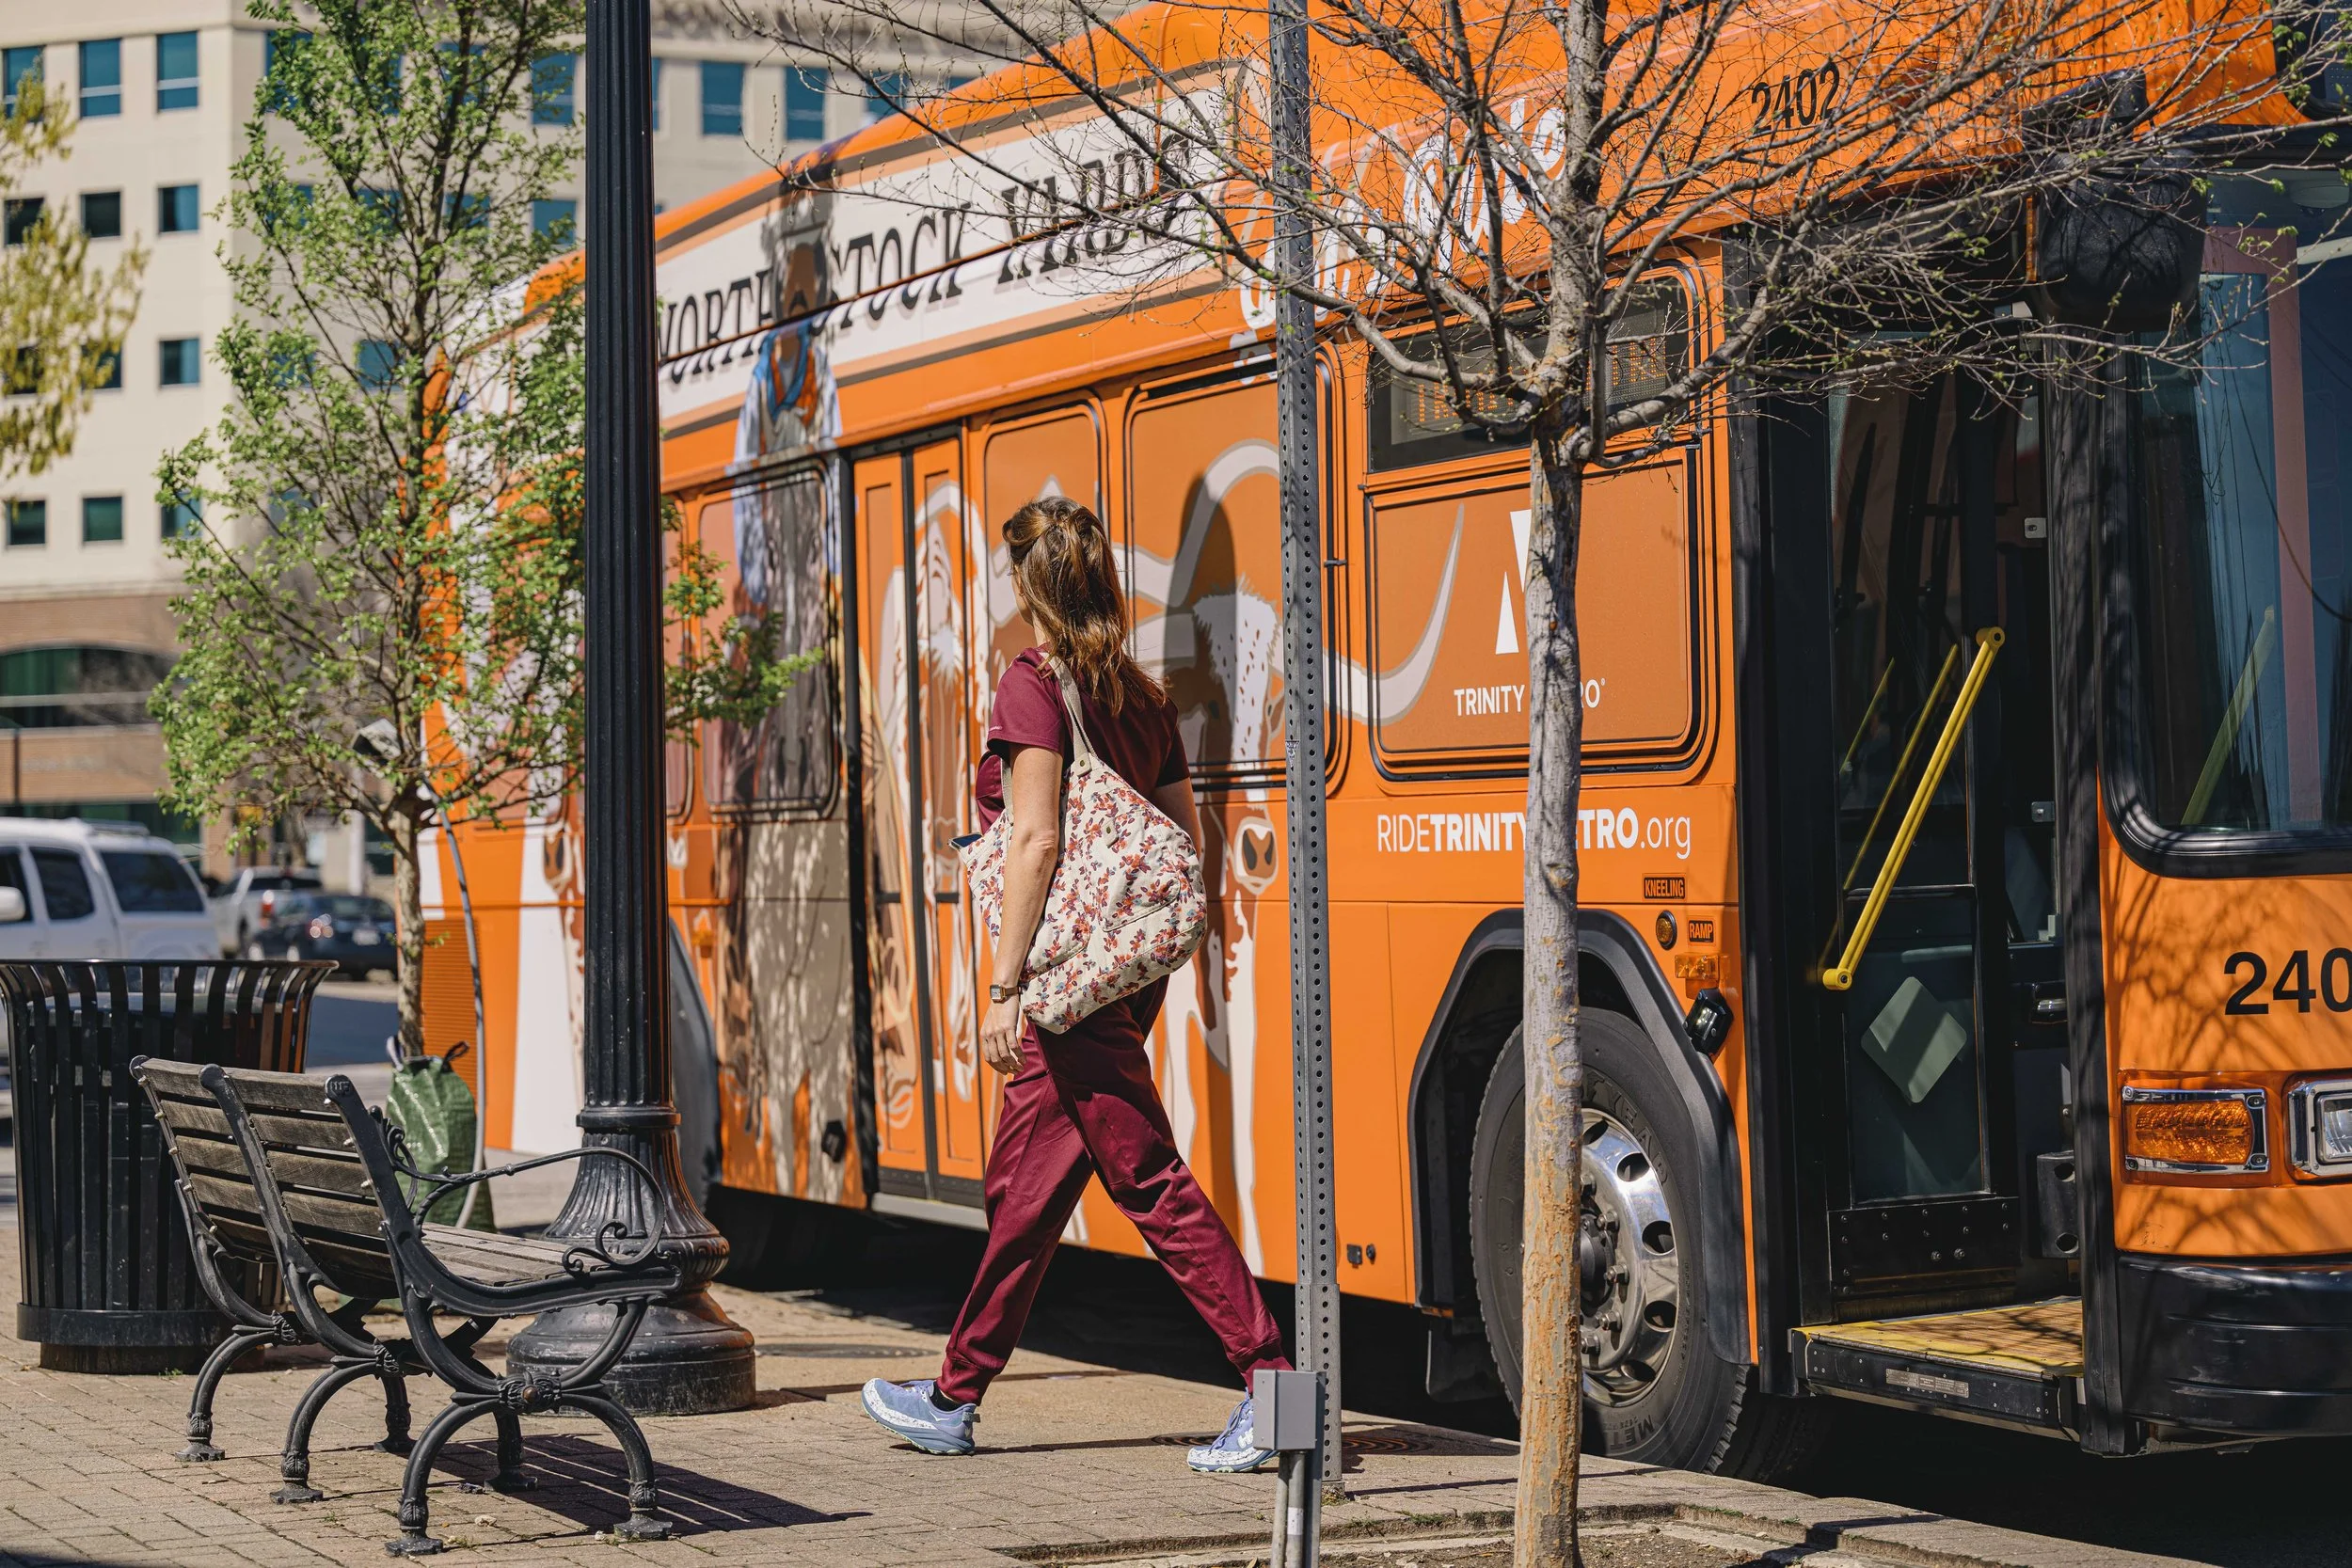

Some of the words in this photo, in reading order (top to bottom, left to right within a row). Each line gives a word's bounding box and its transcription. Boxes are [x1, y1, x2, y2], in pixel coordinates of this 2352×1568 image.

[1751, 62, 1839, 135] 2402
[1454, 684, 1525, 716] TRINITY
[1376, 807, 1692, 860] RIDETRINITTRO.org
[1645, 879, 1685, 897] KNEELING
[1689, 922, 1713, 940] RAMP
[2223, 947, 2352, 1015] 240
